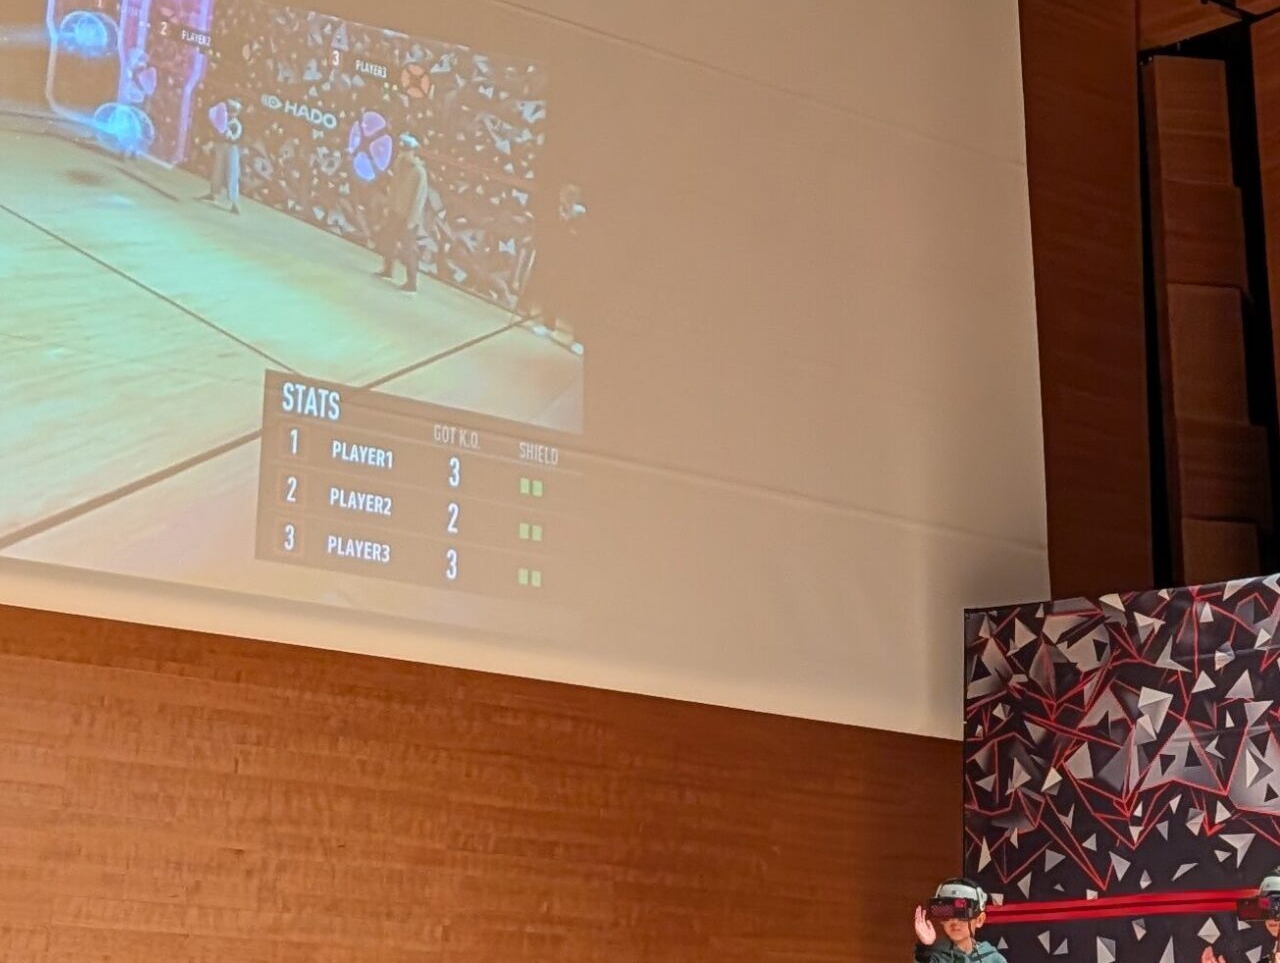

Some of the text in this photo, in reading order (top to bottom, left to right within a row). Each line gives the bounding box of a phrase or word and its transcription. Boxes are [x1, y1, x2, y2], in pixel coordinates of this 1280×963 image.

[160, 21, 168, 35] 2
[332, 50, 387, 79] 3 PLAYER3
[284, 99, 337, 129] HADO
[282, 382, 341, 421] STATS
[433, 424, 480, 451] GOT K.O.
[289, 428, 460, 487] 1 PLAYER1 3
[519, 441, 559, 467] SHIELD
[287, 476, 459, 534] 2 PLAYER2 2
[284, 524, 458, 580] 3 PLAYER3 3
